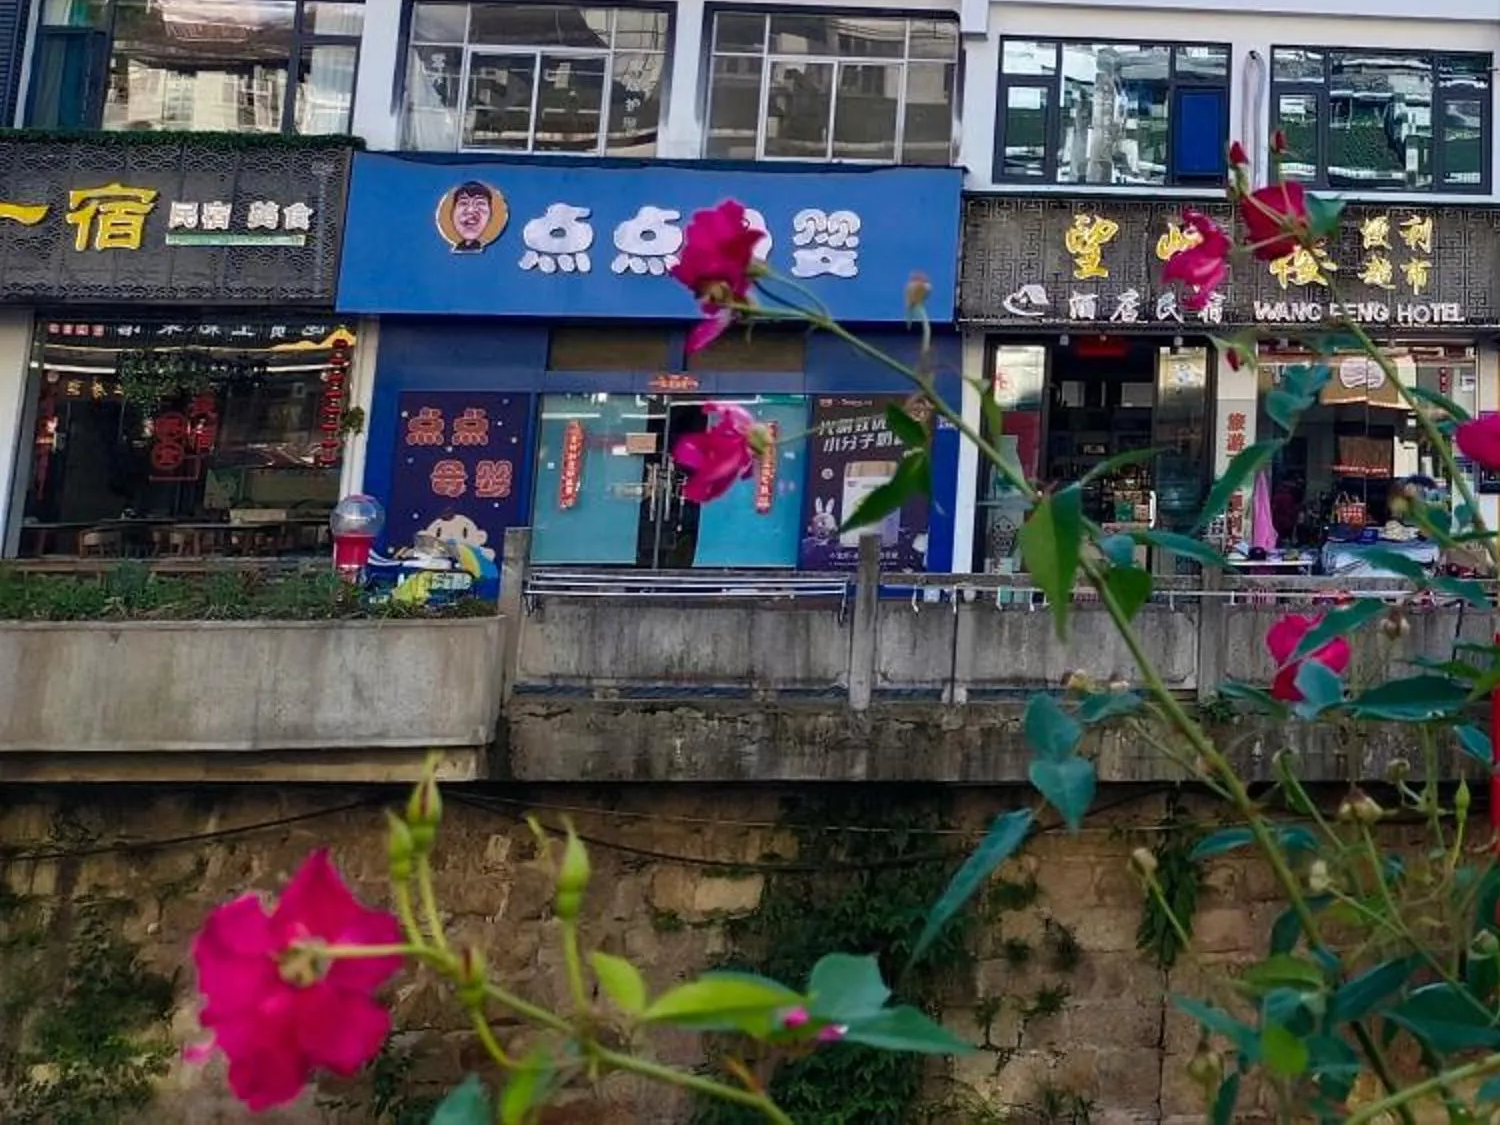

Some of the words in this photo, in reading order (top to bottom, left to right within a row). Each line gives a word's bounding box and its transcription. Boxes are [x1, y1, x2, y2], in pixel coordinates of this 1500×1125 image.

[0, 182, 157, 252] 一宿
[168, 200, 232, 230] 民宿
[247, 200, 313, 230] 美食
[1253, 301, 1323, 322] WANG
[1397, 303, 1465, 323] HOTEL
